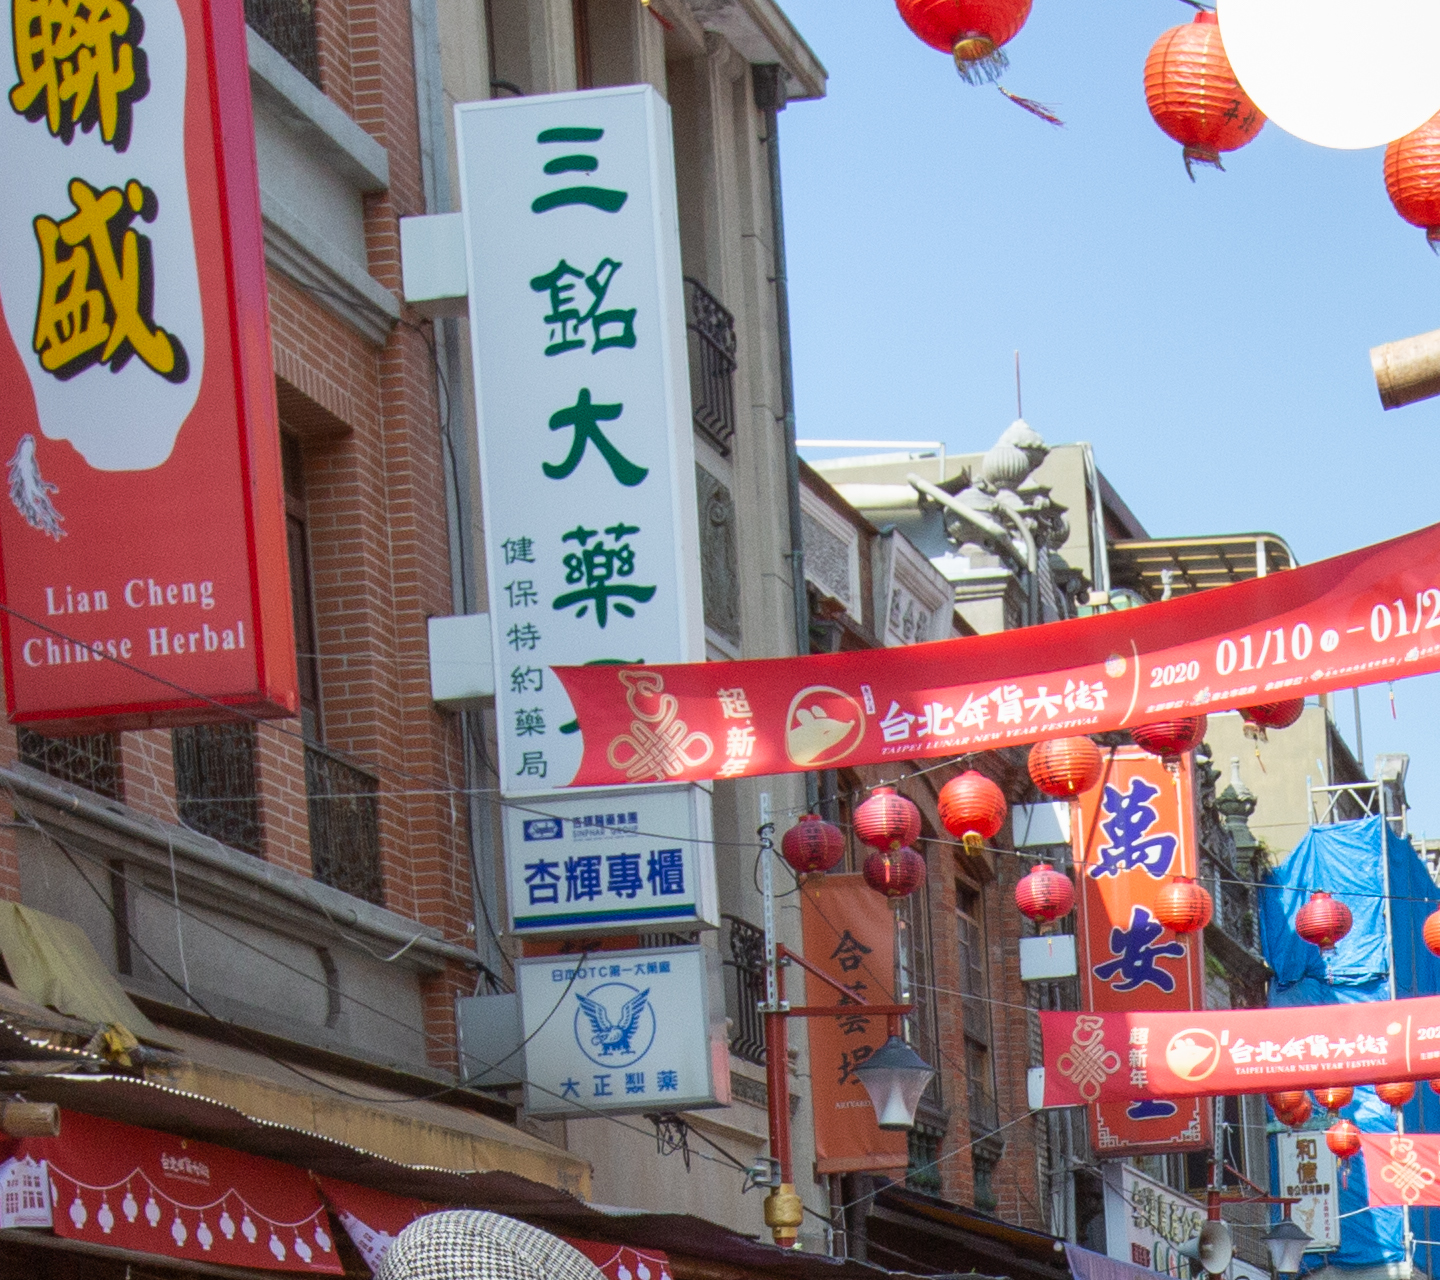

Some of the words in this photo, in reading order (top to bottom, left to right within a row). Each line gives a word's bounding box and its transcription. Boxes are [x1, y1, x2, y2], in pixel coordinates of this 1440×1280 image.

[530, 126, 658, 720] 三銘大藥
[45, 580, 109, 615] Lian
[125, 577, 216, 609] Cheng
[22, 632, 133, 668] Chinese
[148, 622, 246, 658] Herbal
[501, 535, 548, 778] 健保特約藥局
[1150, 661, 1200, 688] 2020
[1216, 623, 1313, 676] 01/10
[880, 679, 1109, 743] 台北年貨大街
[881, 744, 923, 755] TAIPEI
[925, 737, 970, 750] LUNAR
[972, 732, 1006, 744] NEW
[1007, 725, 1038, 738] YEAR
[1040, 716, 1099, 733] FESTIVAL
[524, 848, 685, 906] 杏輝專櫃
[1090, 777, 1186, 1119] 萬安
[1229, 1035, 1388, 1063] 台北年貨大街
[1235, 1066, 1264, 1075] TAIPEI
[1266, 1064, 1296, 1074] LUNAR
[1298, 1063, 1320, 1072] NEW
[1321, 1061, 1345, 1071] YEAR
[1346, 1059, 1388, 1069] FESTIVAL
